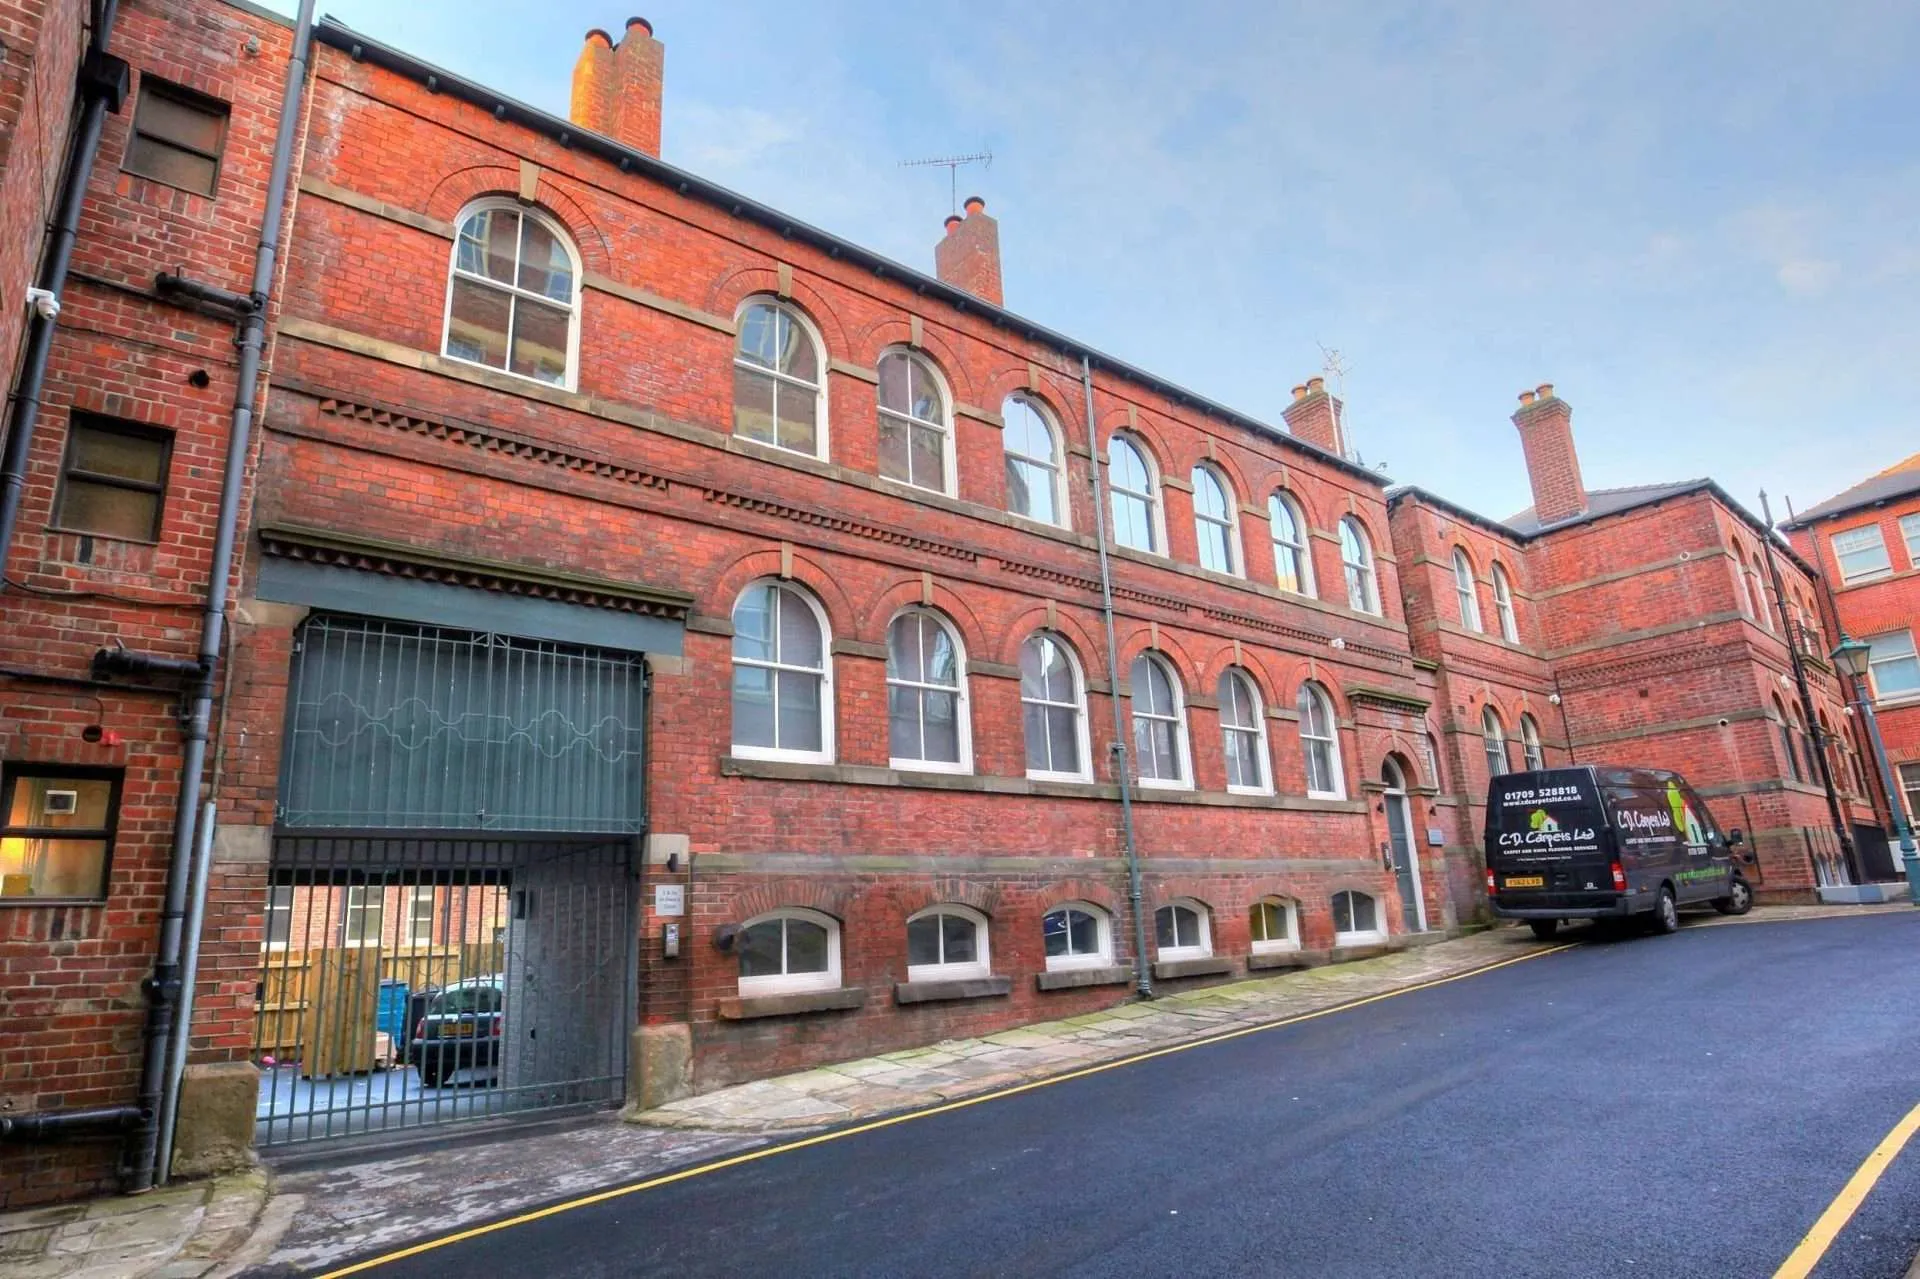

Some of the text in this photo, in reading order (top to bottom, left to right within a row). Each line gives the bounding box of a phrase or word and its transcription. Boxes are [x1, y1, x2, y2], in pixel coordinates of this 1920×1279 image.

[1505, 790, 1535, 800] 01709
[1634, 809, 1661, 836] Carpets
[1525, 832, 1571, 847] Carpets
[1573, 828, 1595, 841] Ltd
